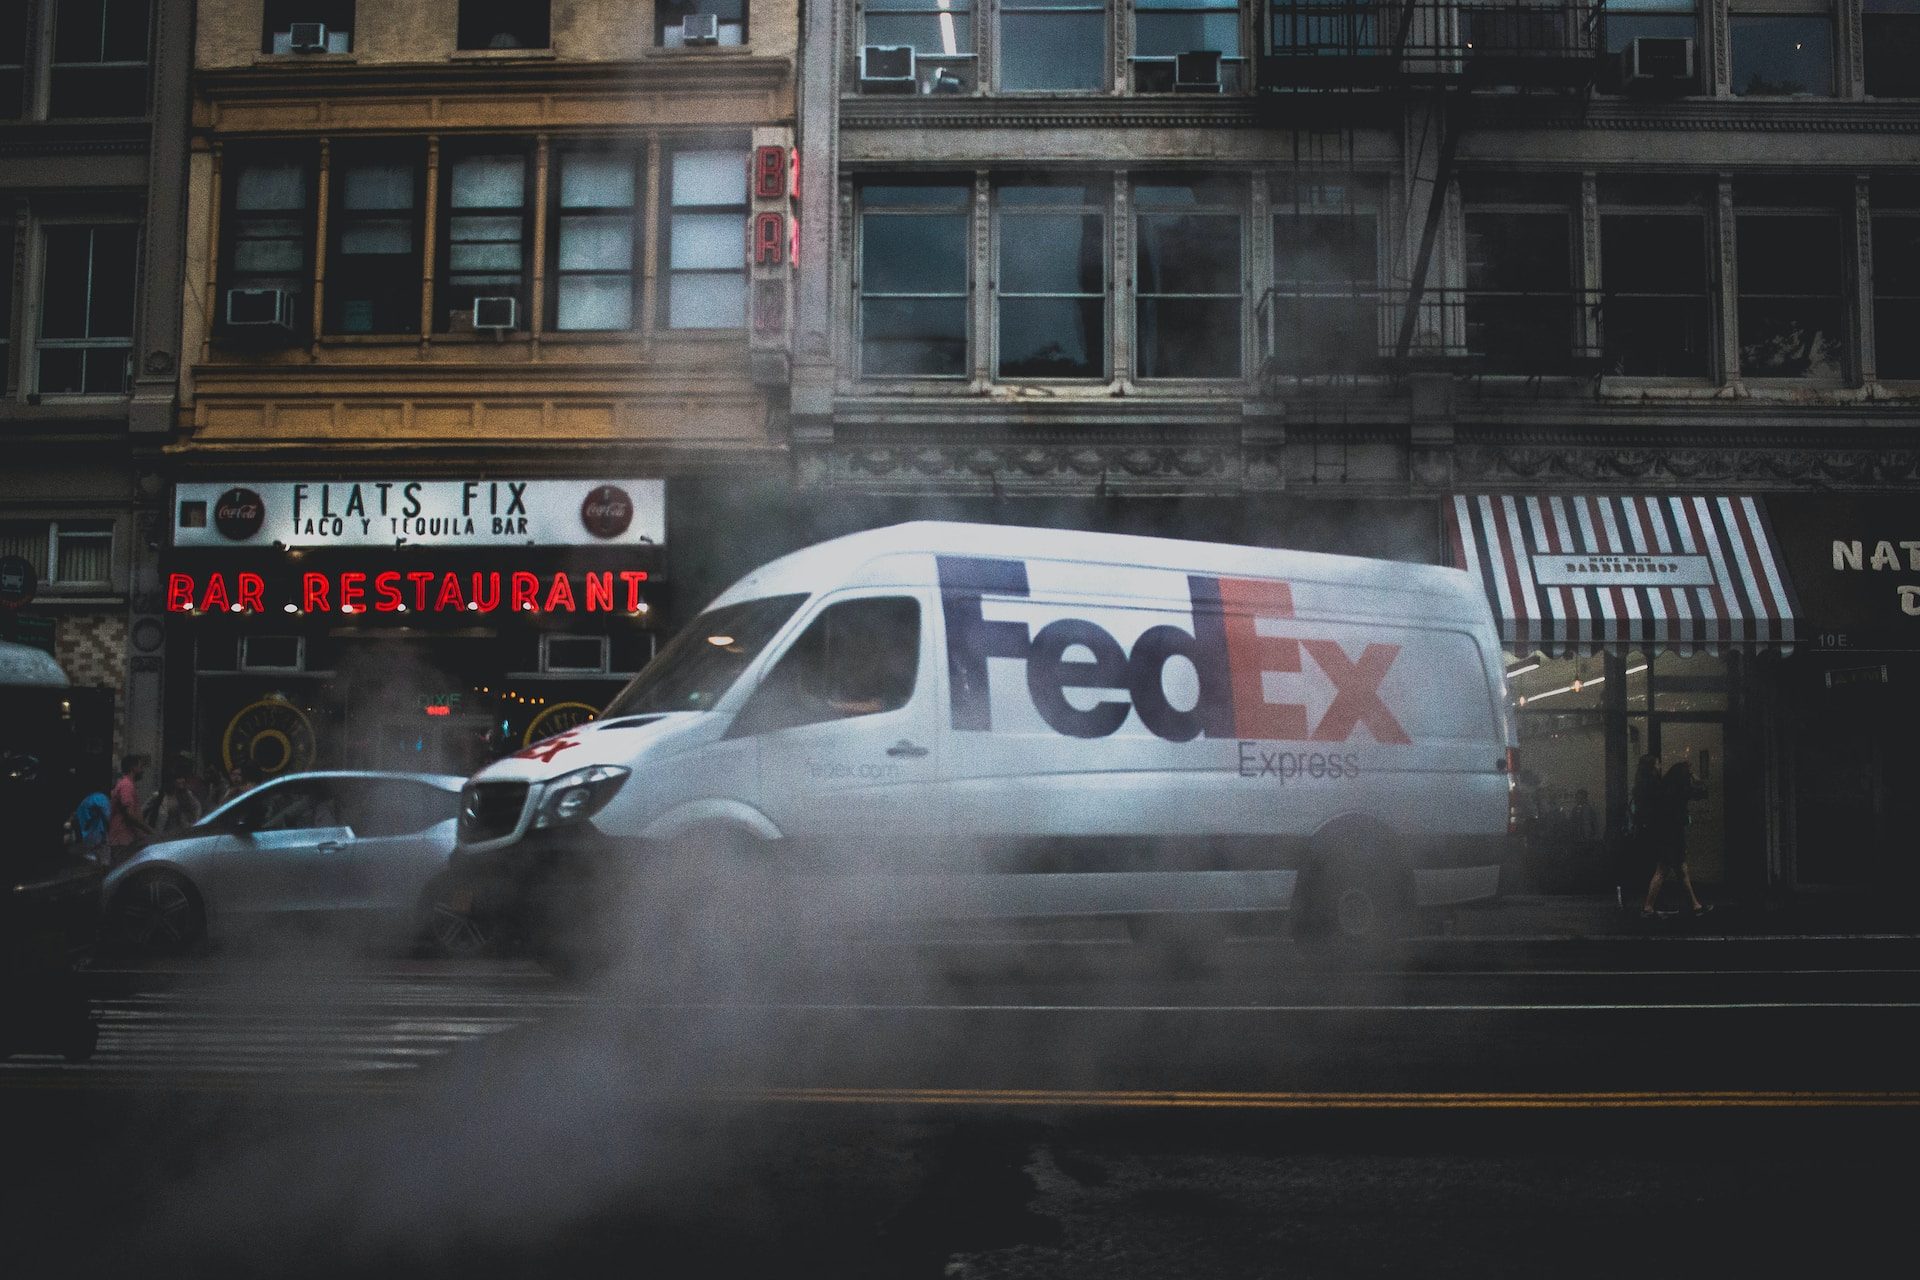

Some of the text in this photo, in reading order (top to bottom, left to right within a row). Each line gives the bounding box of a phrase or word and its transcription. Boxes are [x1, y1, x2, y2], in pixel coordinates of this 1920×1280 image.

[294, 482, 528, 518] FLATS FIX
[294, 518, 343, 536] TACO
[361, 518, 371, 536] Y
[492, 517, 528, 535] BAR
[1565, 562, 1679, 573] BARBERSHOP
[167, 571, 648, 613] BAR RESTAURANT
[935, 555, 1413, 745] FedEx
[1237, 741, 1361, 785] Express
